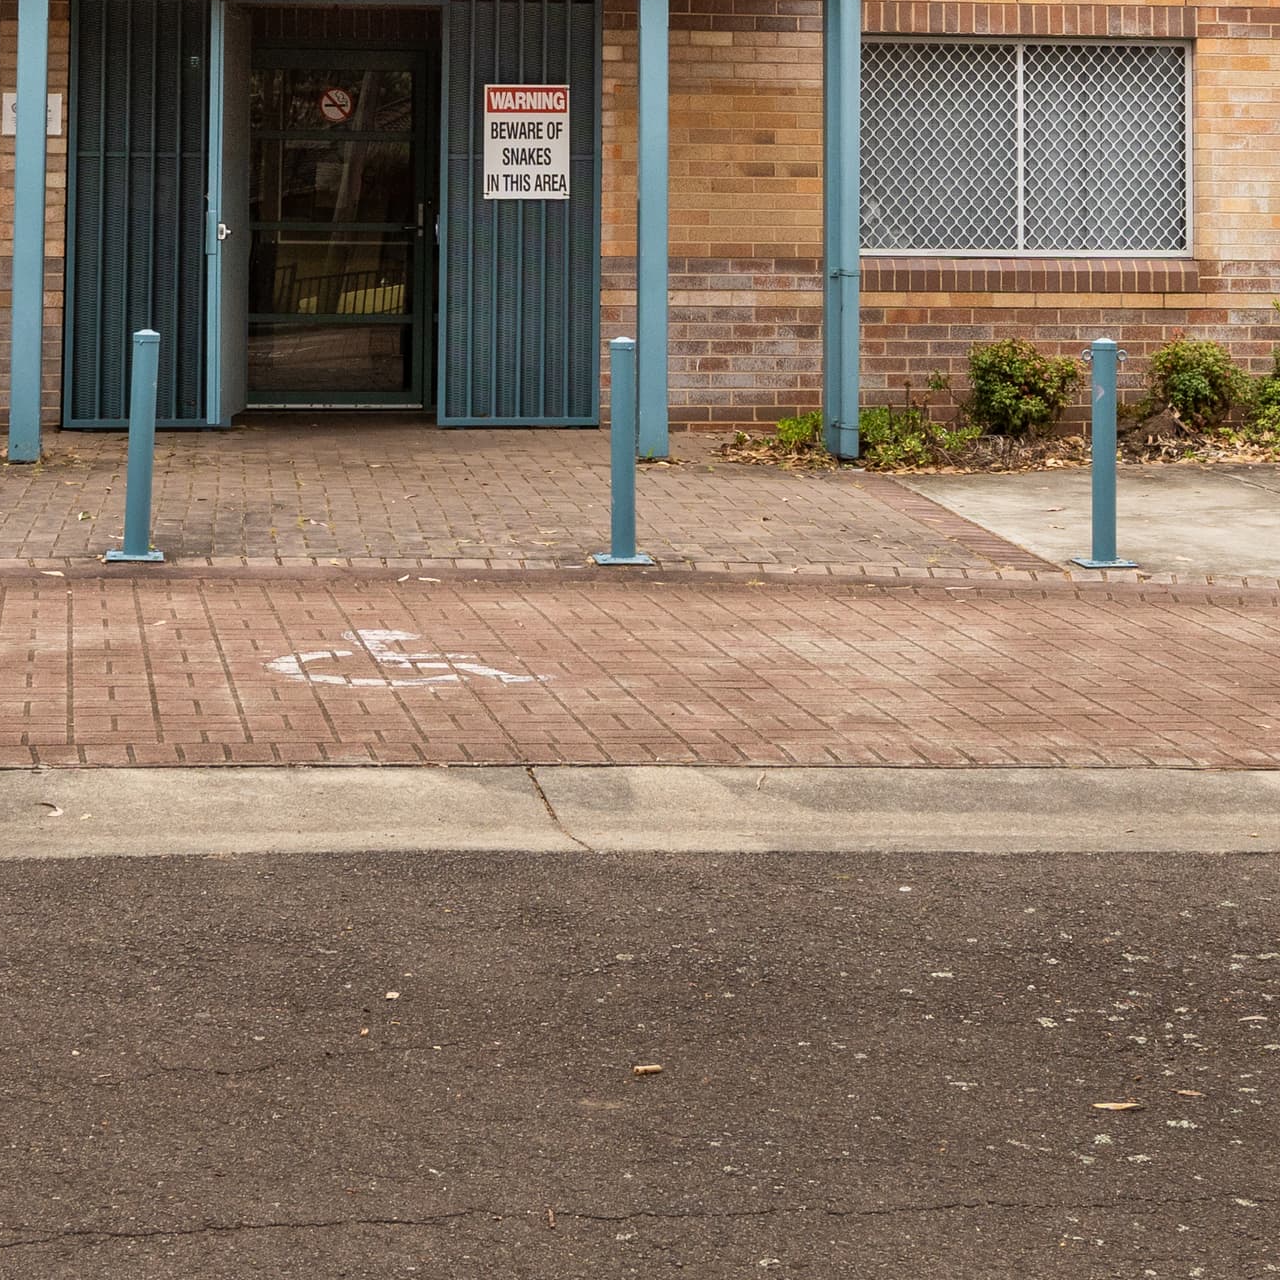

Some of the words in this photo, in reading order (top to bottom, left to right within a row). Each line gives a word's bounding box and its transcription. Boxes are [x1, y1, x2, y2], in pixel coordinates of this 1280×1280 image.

[489, 91, 566, 110] WARNING
[491, 122, 543, 139] BEWARE
[547, 122, 563, 139] OF
[502, 147, 552, 166] SNAKES
[487, 174, 499, 192] IN
[502, 174, 531, 192] THIS
[534, 174, 567, 192] AREA
